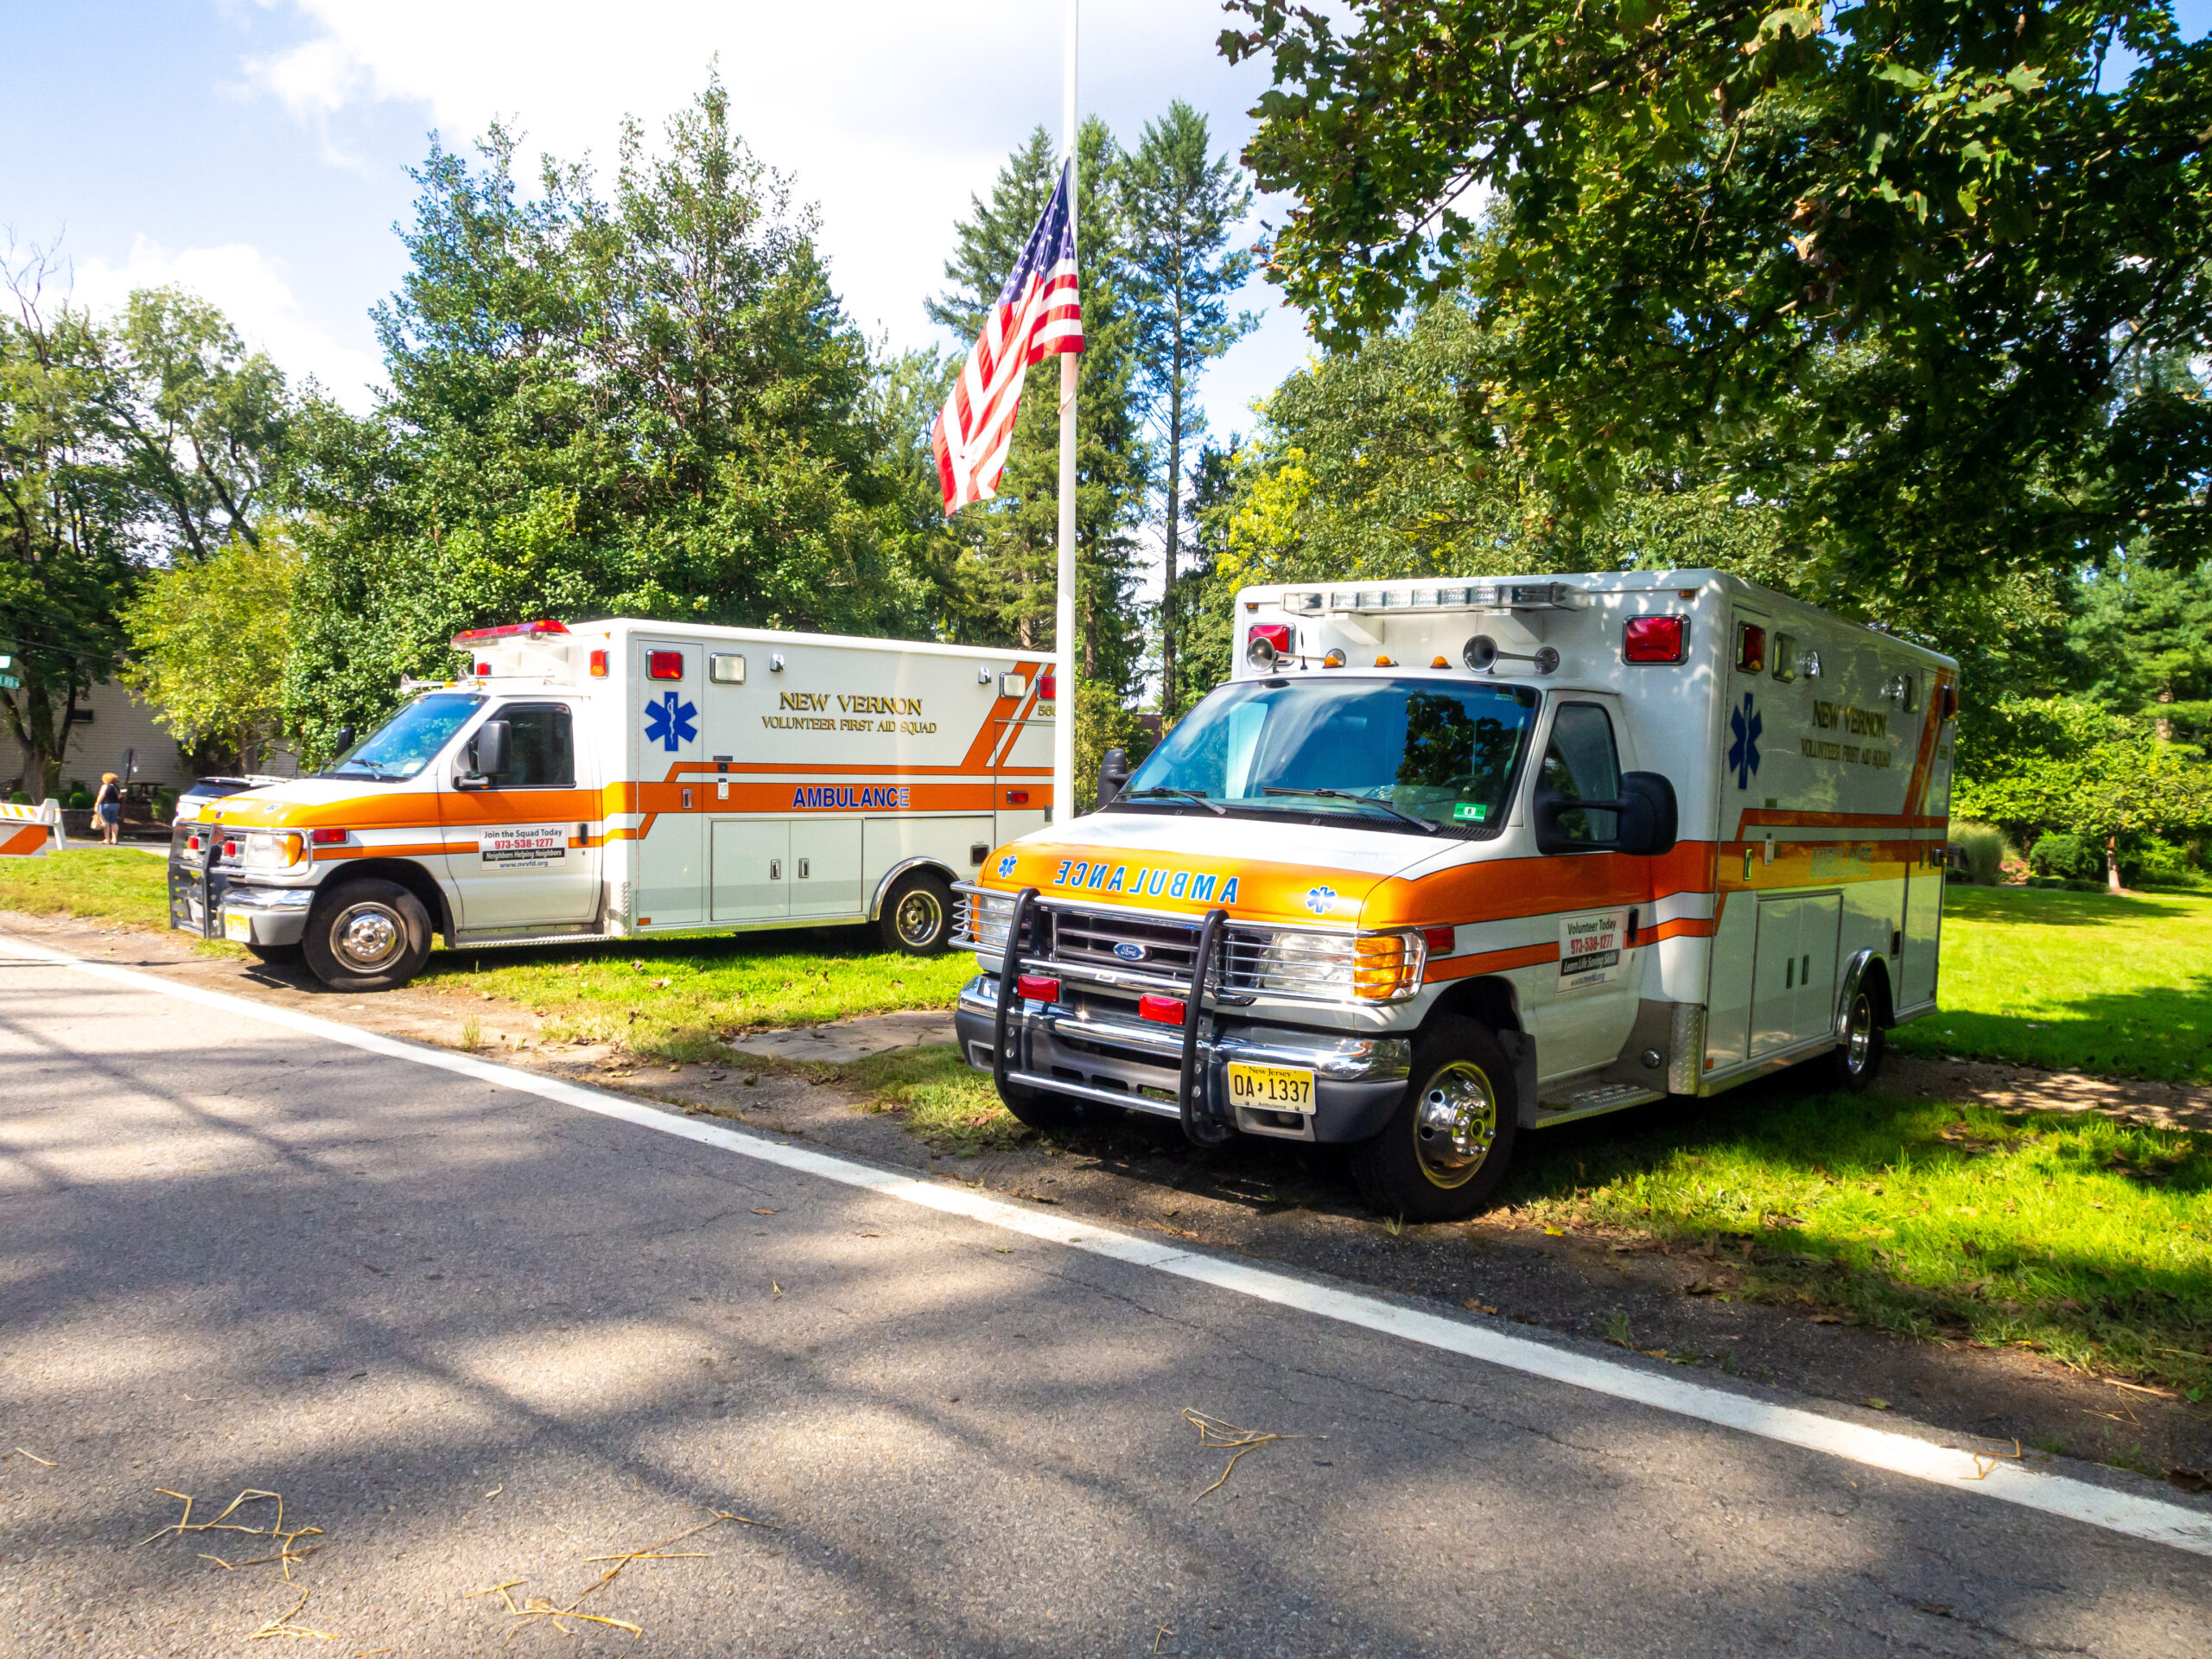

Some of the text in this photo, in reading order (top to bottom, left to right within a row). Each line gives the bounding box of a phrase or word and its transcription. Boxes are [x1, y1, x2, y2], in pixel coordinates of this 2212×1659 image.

[779, 692, 923, 716] NEW VERNON
[1812, 699, 1844, 732] NEW
[762, 716, 938, 735] VOLUNTEER FIRST AID SQUAD
[791, 787, 910, 808] AMBULANCE
[516, 830, 539, 839] Squad
[540, 829, 563, 837] Today
[494, 838, 553, 849] 973-538-1277
[486, 849, 562, 861] Neighbors Helping Neighbors
[1567, 918, 1617, 935] Volunteer Today
[1120, 945, 1137, 957] Ford
[1571, 934, 1614, 955] 973-538-1277
[1564, 961, 1579, 973] Learn
[1268, 1068, 1292, 1078] Jersey
[1268, 1077, 1310, 1103] 1337
